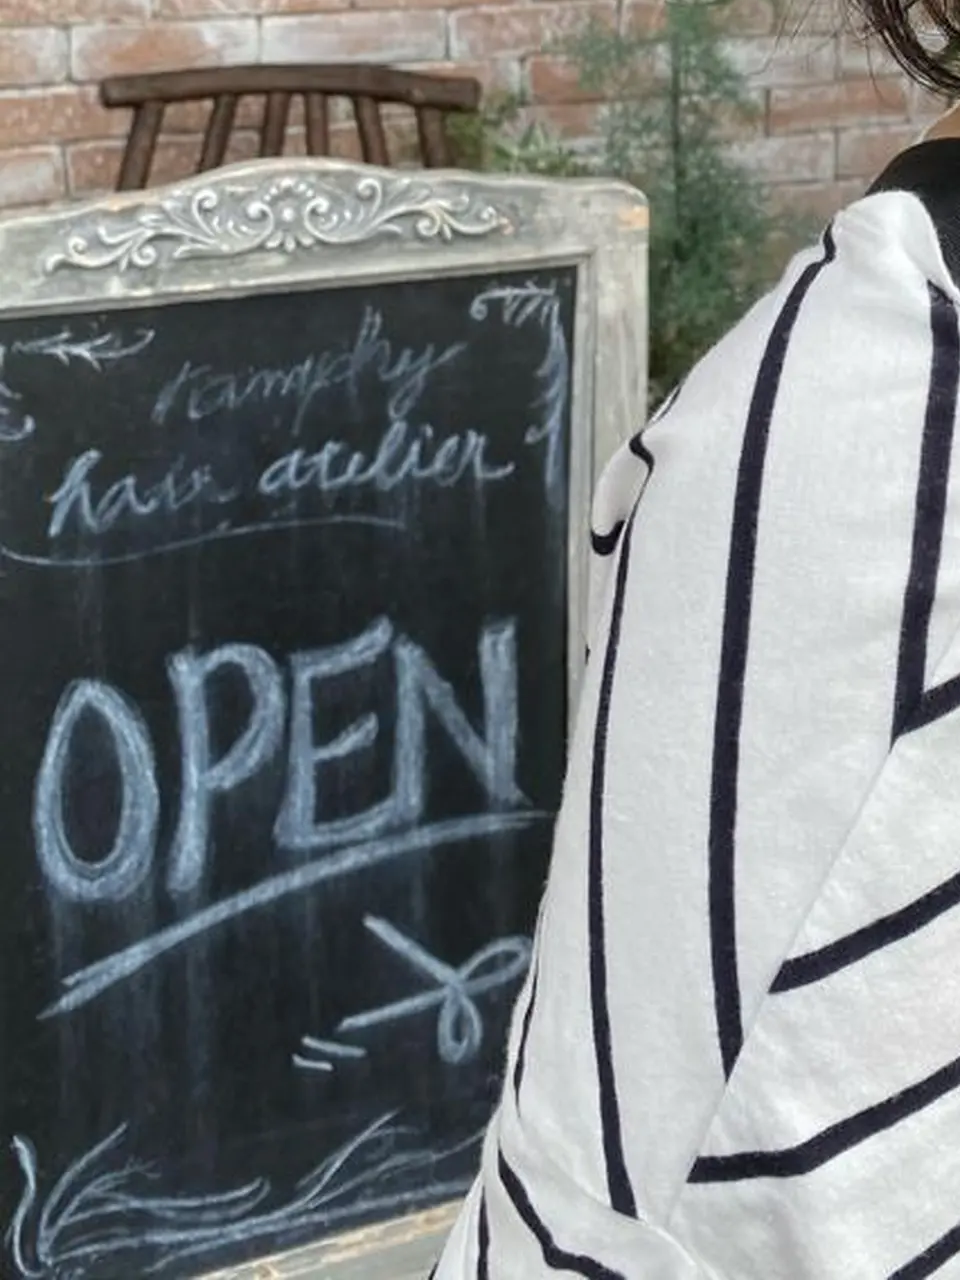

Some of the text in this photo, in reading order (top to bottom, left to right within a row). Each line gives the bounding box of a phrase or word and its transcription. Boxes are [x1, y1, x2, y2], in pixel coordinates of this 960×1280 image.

[48, 420, 515, 537] hair atelier
[34, 616, 533, 902] OPEN
